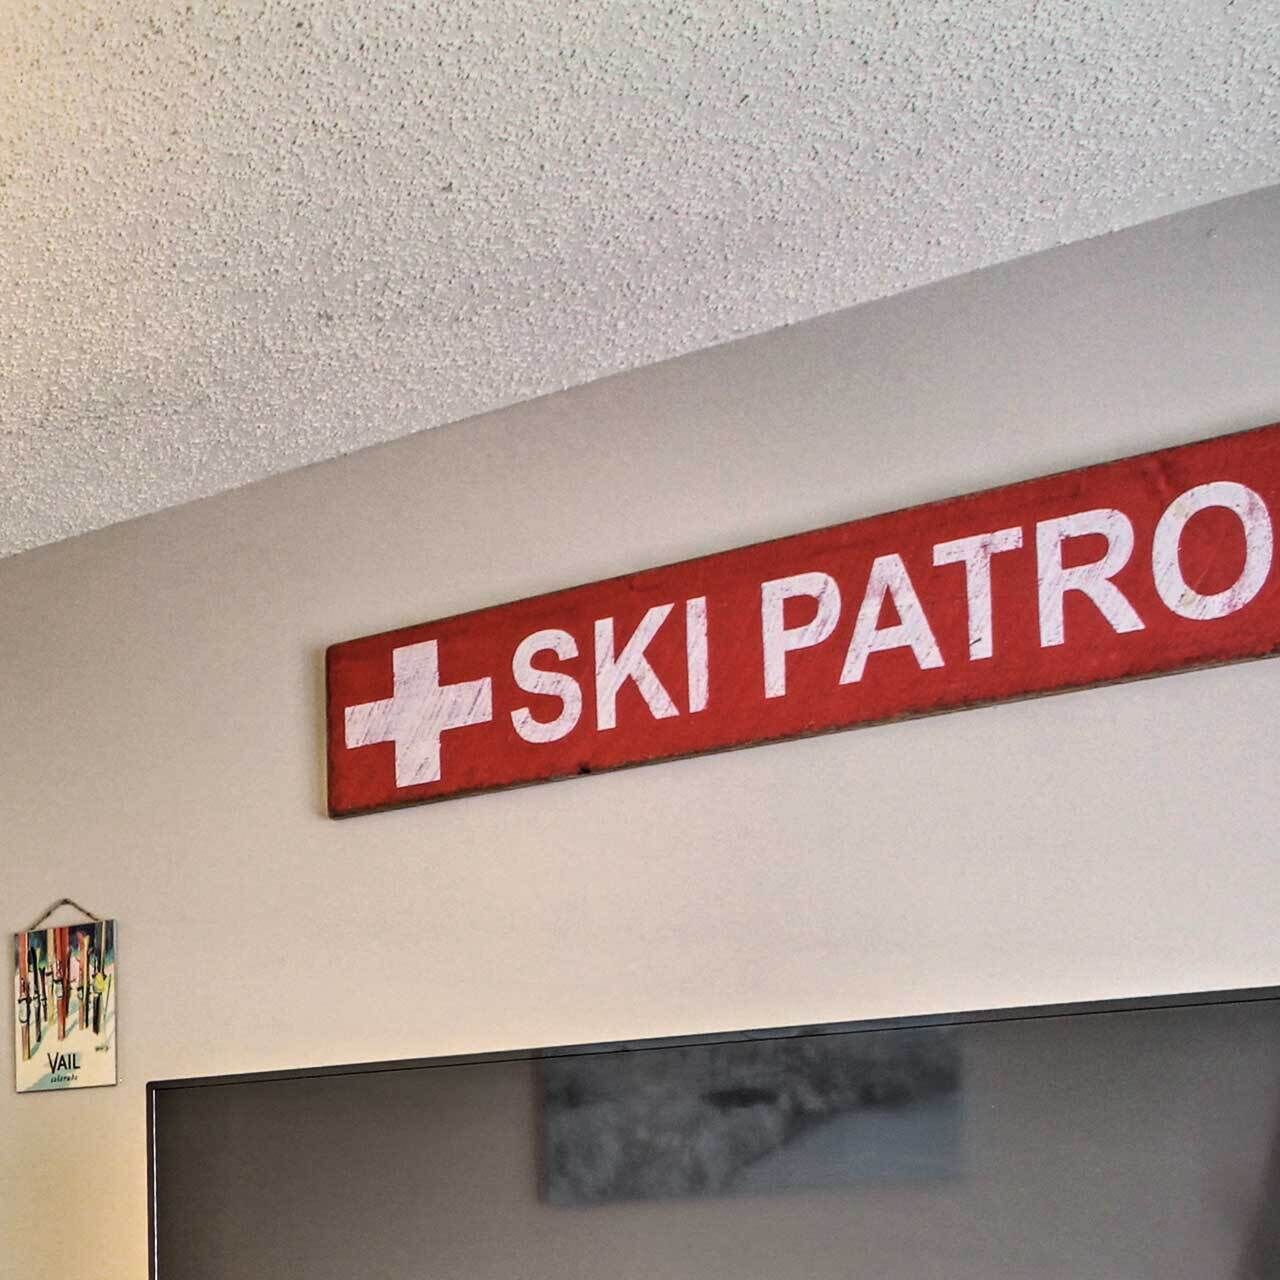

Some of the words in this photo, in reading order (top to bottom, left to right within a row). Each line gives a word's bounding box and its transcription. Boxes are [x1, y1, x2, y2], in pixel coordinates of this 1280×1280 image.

[511, 596, 710, 744] SKI
[761, 481, 1275, 698] PATRO
[47, 1052, 80, 1074] VAIL
